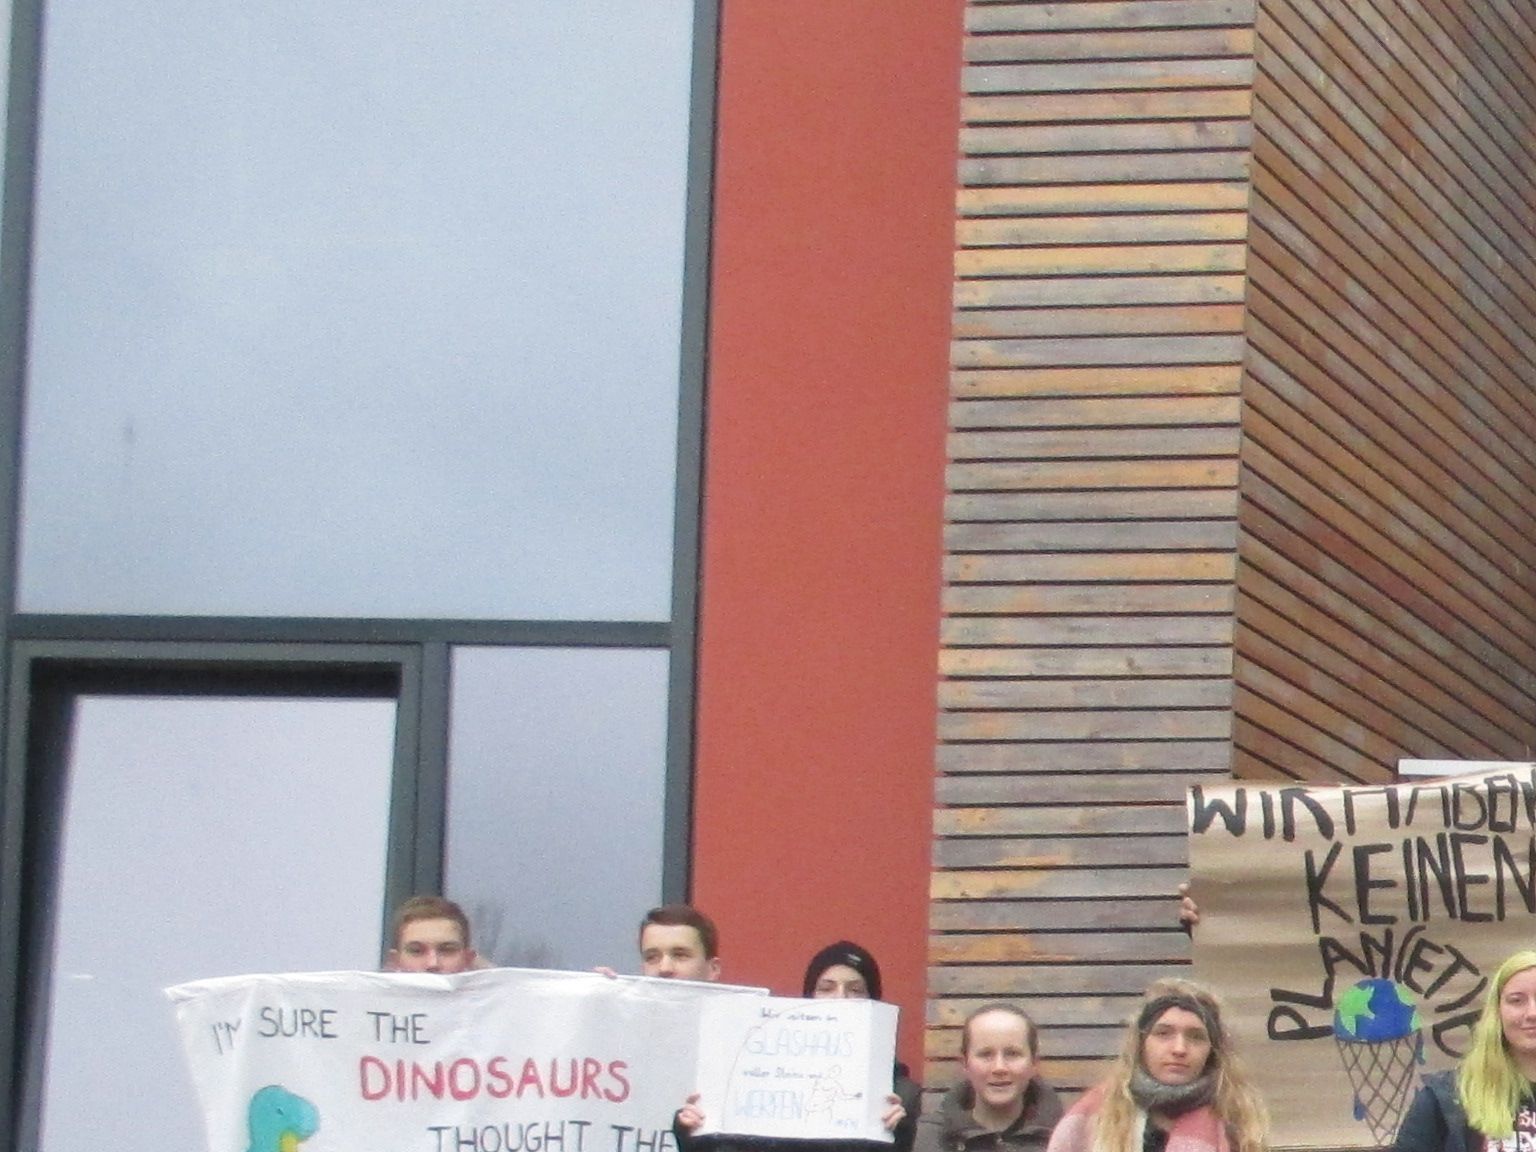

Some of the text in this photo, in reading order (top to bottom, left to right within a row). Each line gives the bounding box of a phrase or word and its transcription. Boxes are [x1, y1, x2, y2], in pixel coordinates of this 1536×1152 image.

[259, 1006, 338, 1038] SURE
[367, 1011, 431, 1044] THE
[360, 1056, 631, 1101] DINOSAURS
